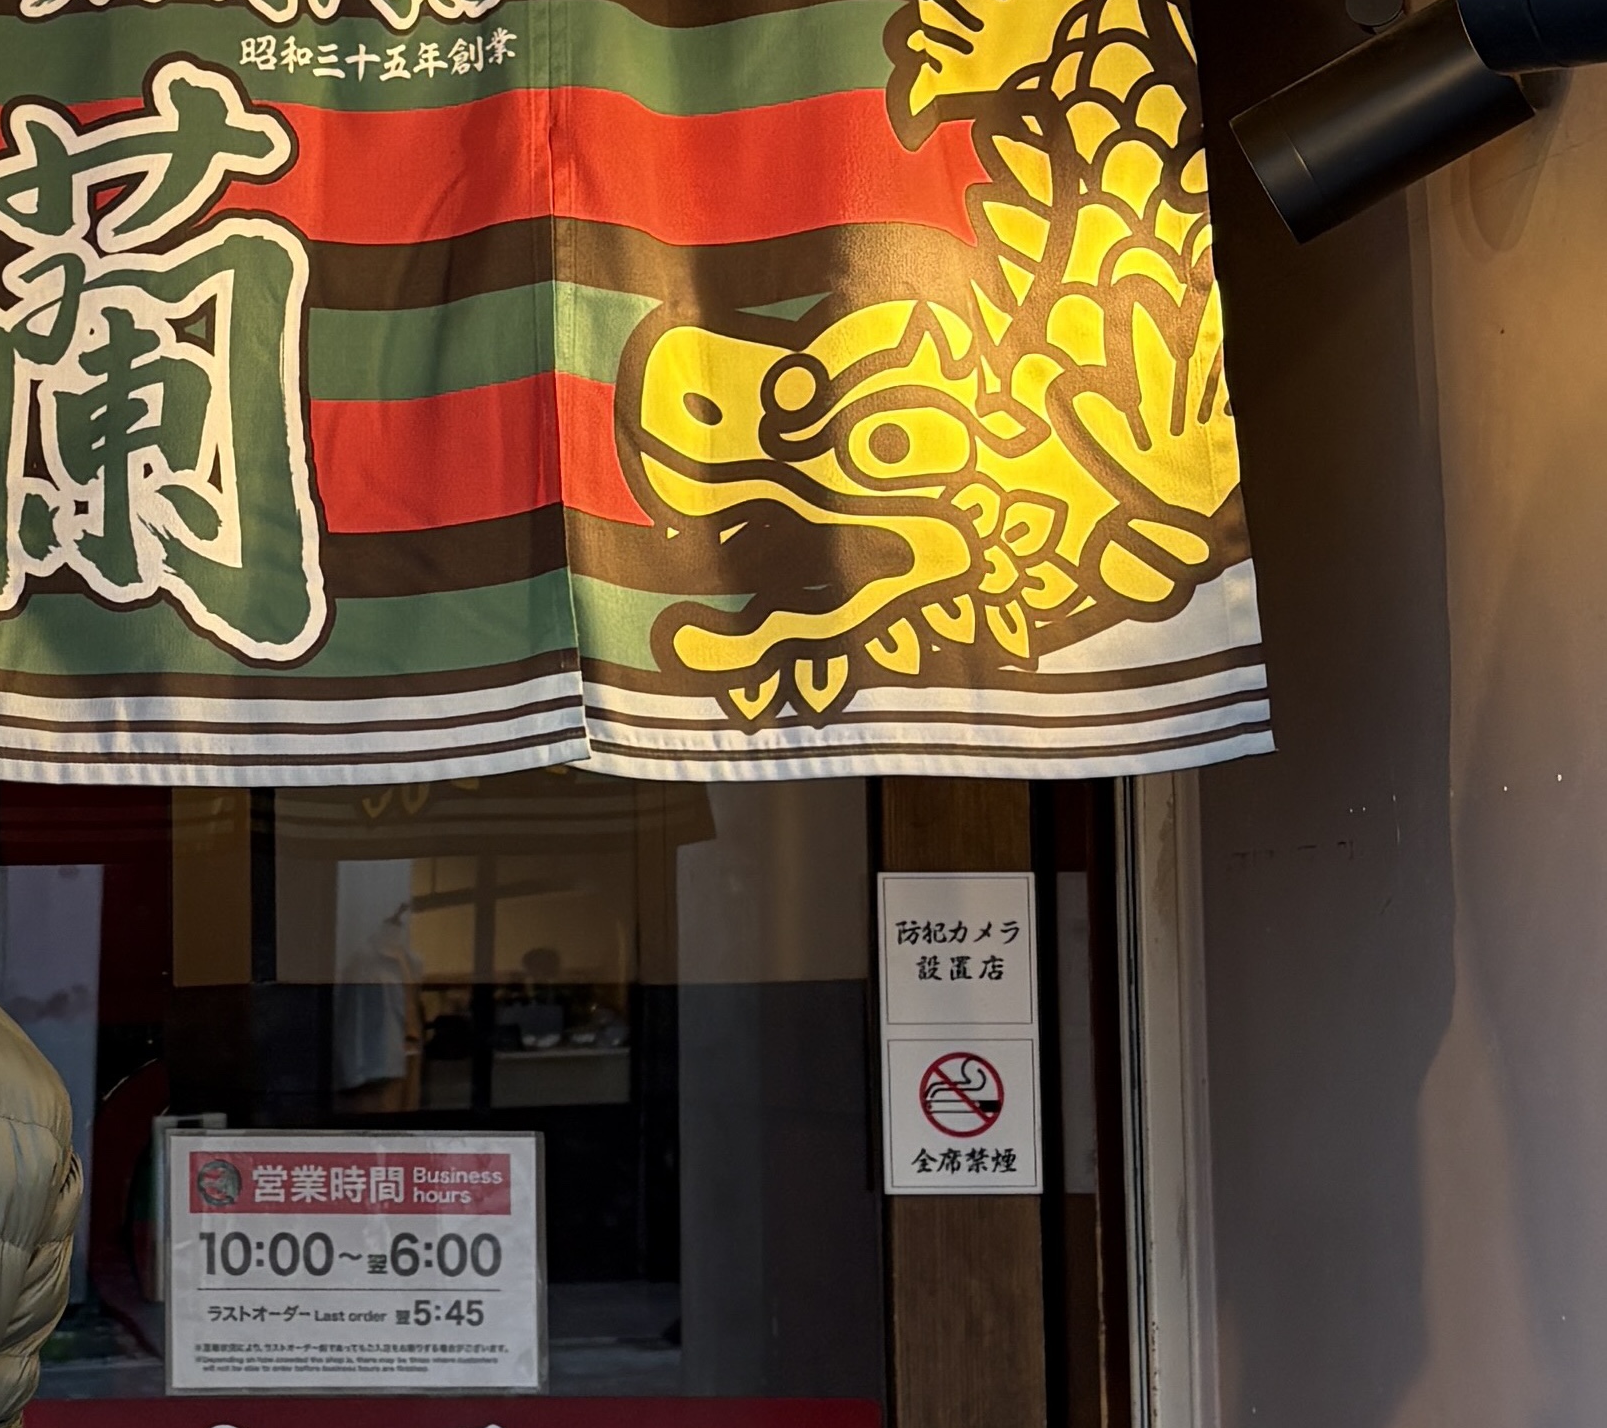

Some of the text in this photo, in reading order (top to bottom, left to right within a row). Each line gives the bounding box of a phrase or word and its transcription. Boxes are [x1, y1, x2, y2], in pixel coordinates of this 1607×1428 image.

[239, 28, 518, 81] 昭和三十五年創業
[895, 920, 1020, 945] 防犯カメラ
[915, 955, 1005, 981] 設置店
[911, 1147, 1017, 1175] 全席禁煙
[252, 1164, 405, 1204] 営業時間
[413, 1166, 503, 1186] Business
[413, 1187, 472, 1205] hours
[206, 1304, 310, 1323] ラストオーダー
[314, 1309, 345, 1323] Last
[348, 1309, 388, 1324] order
